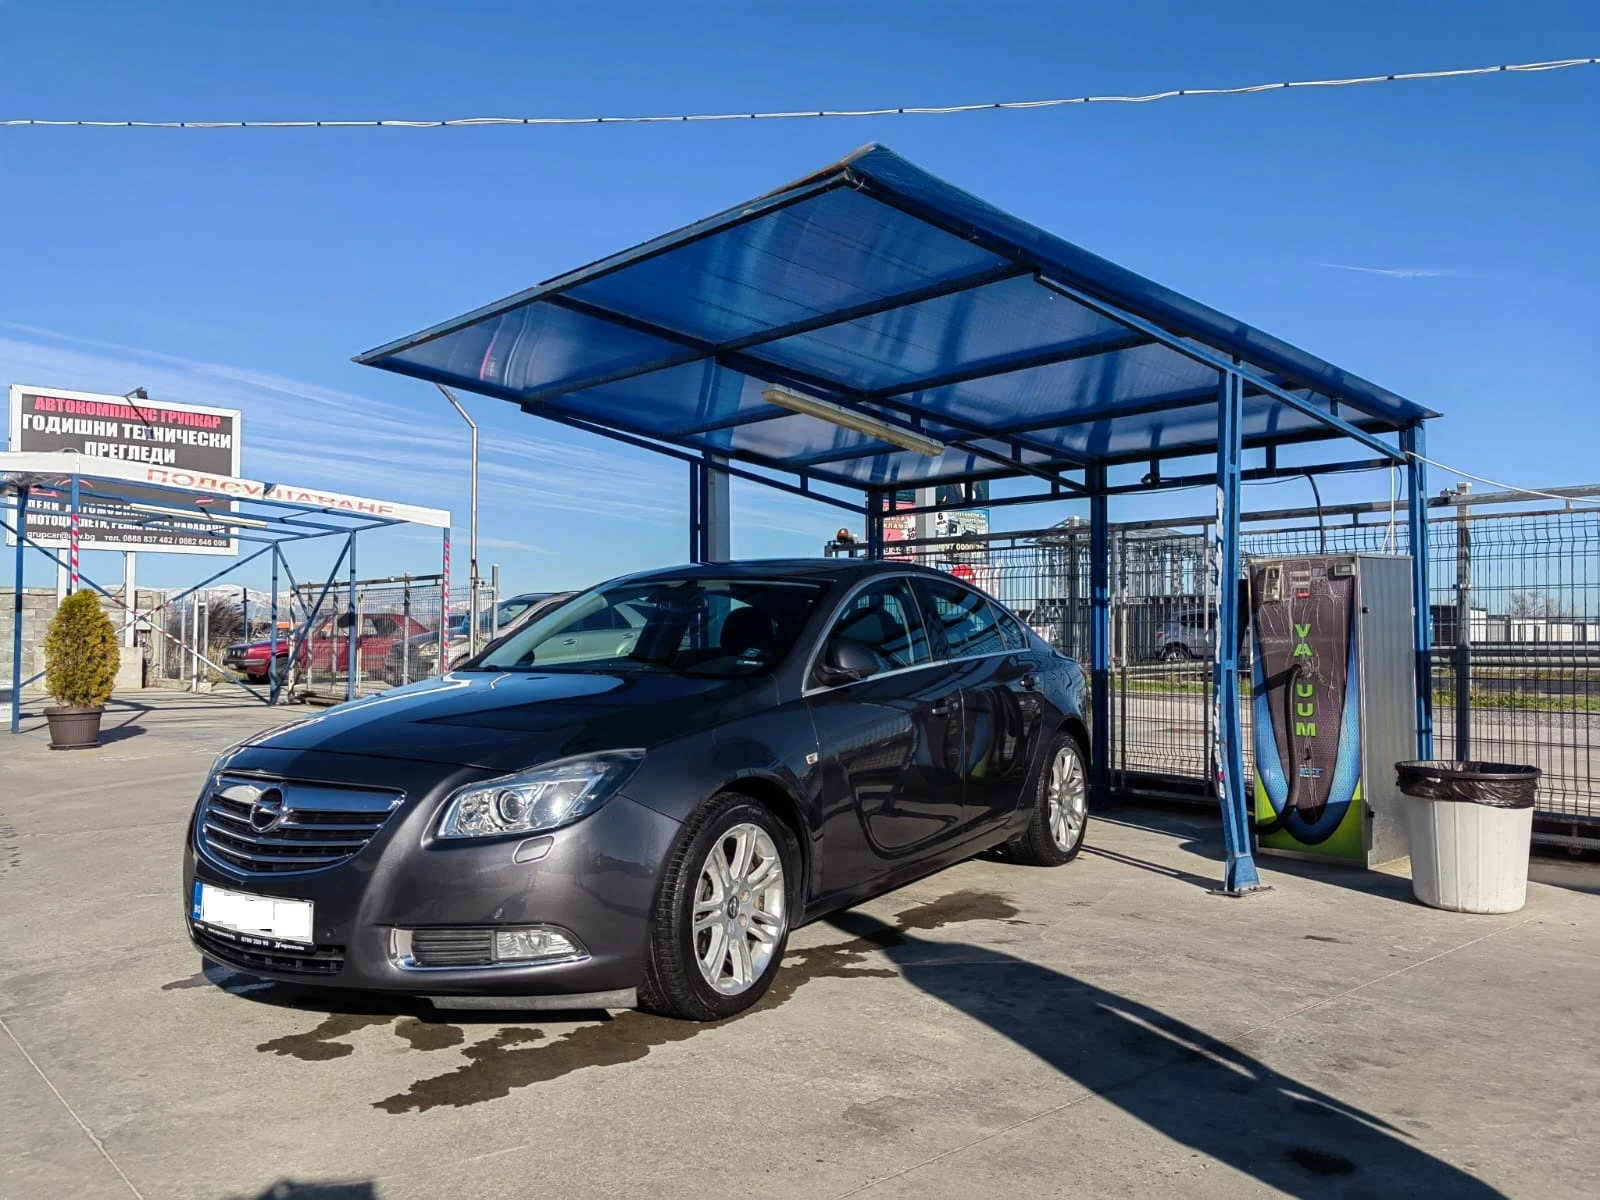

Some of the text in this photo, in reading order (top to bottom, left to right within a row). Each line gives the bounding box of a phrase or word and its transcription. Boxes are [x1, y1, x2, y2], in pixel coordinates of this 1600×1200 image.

[22, 413, 118, 438] ГОДИШНИ
[35, 397, 221, 429] АВТОКОМПЛЕКС ГРУПКАР
[84, 441, 175, 465] ПРЕГЛЕДИ
[1294, 623, 1316, 737] VAUUM
